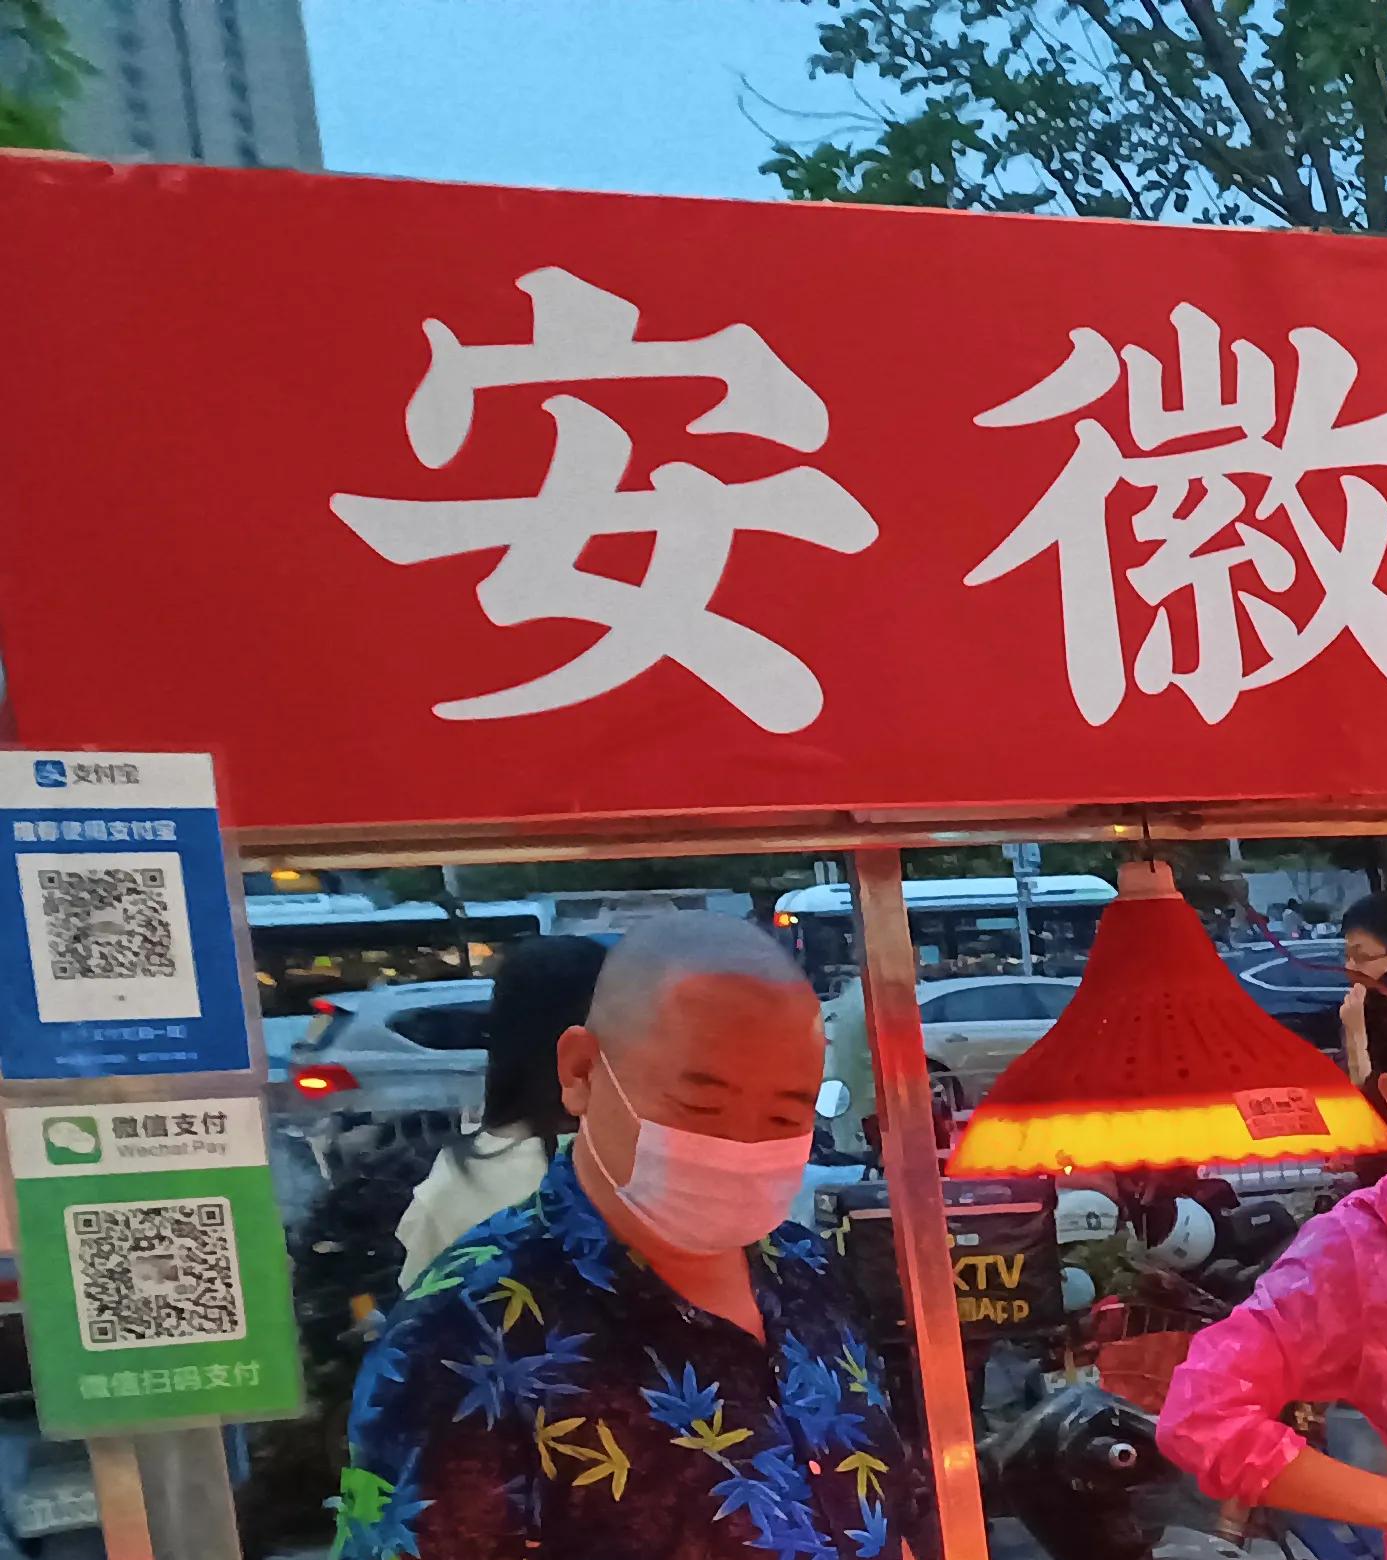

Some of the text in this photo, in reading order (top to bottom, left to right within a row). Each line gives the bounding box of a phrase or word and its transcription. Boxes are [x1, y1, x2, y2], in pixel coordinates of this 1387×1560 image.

[73, 763, 139, 784] 支付宝
[112, 1111, 227, 1138] 微信支付
[79, 1361, 260, 1399] 微信扫码支付
